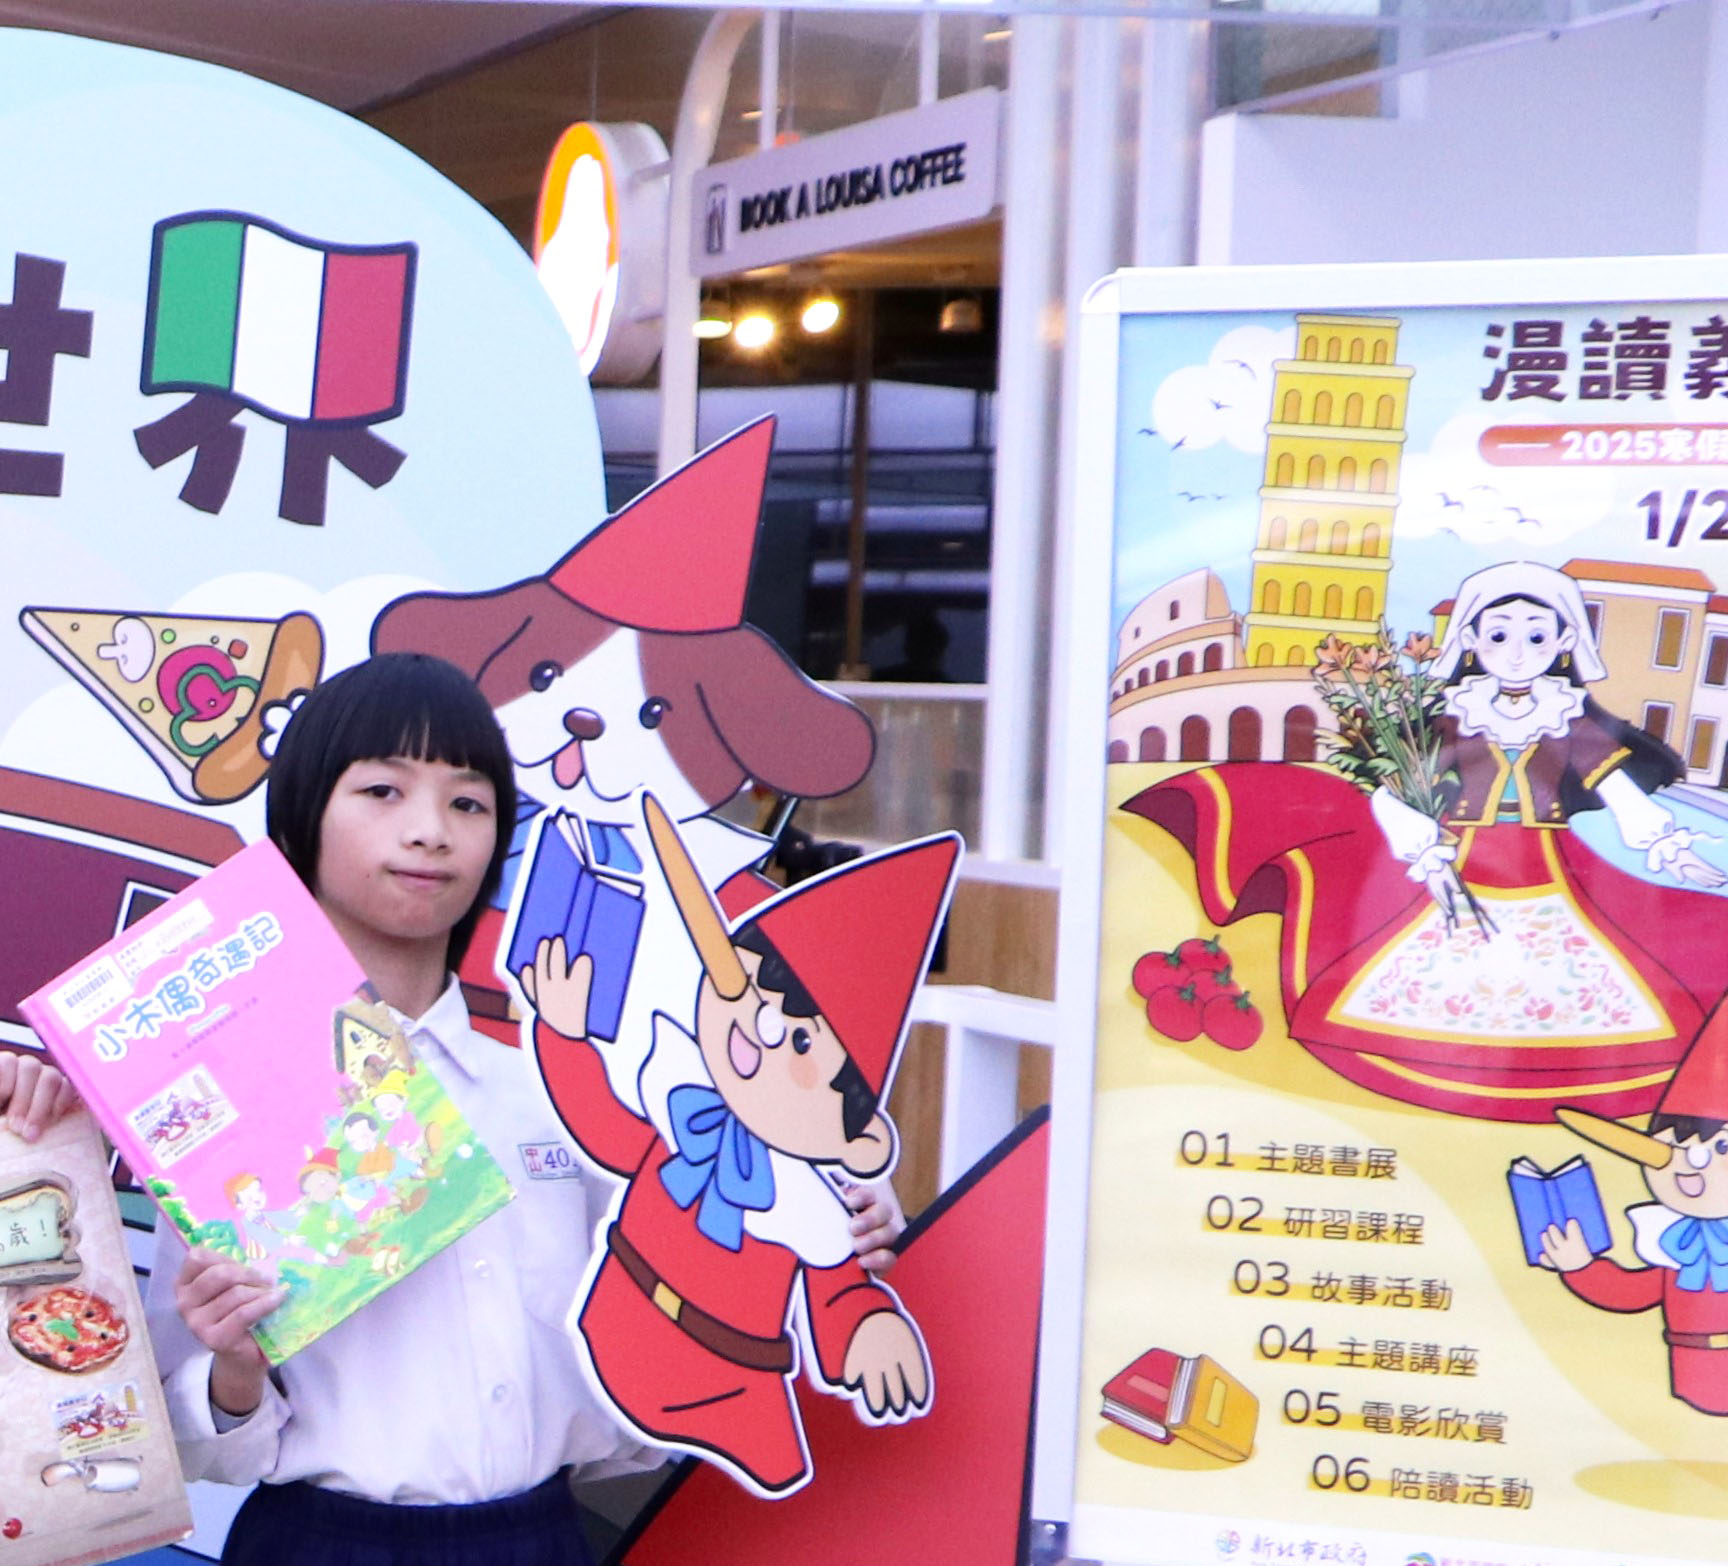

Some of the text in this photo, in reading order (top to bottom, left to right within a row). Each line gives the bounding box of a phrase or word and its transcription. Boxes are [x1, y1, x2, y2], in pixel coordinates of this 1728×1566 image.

[740, 142, 968, 233] BOOK A LOUISA COFFEE
[97, 915, 280, 1058] 小木偶奇遇記
[1180, 1130, 1399, 1181] 01 主題書展
[1206, 1195, 1426, 1247] 02 研習課程
[1233, 1260, 1453, 1312] 03 故事活動
[1259, 1324, 1480, 1377] 04 主題講座
[1283, 1389, 1509, 1445] 05 電影欣賞
[1312, 1454, 1535, 1510] 06 陪讀活動
